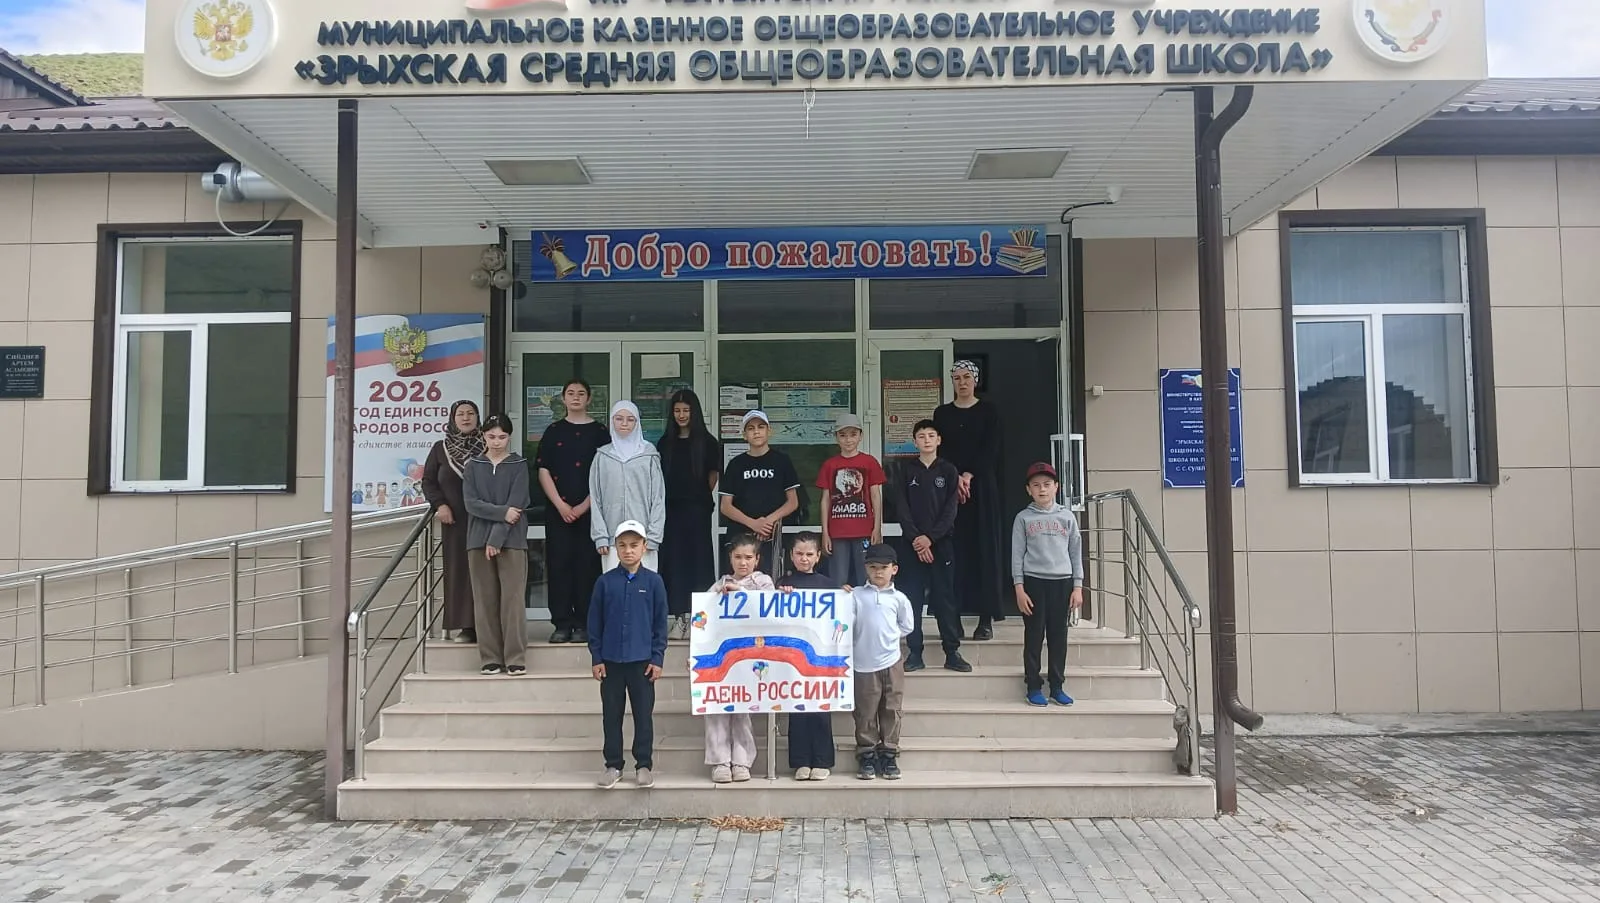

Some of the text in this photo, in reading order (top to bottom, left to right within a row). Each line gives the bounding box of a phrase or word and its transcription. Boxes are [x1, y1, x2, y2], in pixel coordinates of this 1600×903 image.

[317, 8, 1321, 48] МУНИЦИПАЛЬНОЕ КАЗЕННОЕ ОБЩЕОБРАЗОВАТЕЛЬНОЕ УЧРЕЖДЕНИЕ
[294, 41, 1333, 88] «ЗРЫХСКАЯ СРЕДНЯЯ ОБЩЕОБРАЗОВАТЕЛЬНАЯ ШКОЛА»
[581, 230, 992, 278] Добро пожаловать!
[369, 380, 442, 402] 2026
[384, 407, 449, 419] ЕДИНСТВ
[743, 469, 775, 479] BOOS
[832, 503, 867, 513] KHABIB
[719, 591, 836, 619] 12 ИЮНЯ
[702, 679, 845, 704] ДЕНЬ РОССИИ!
